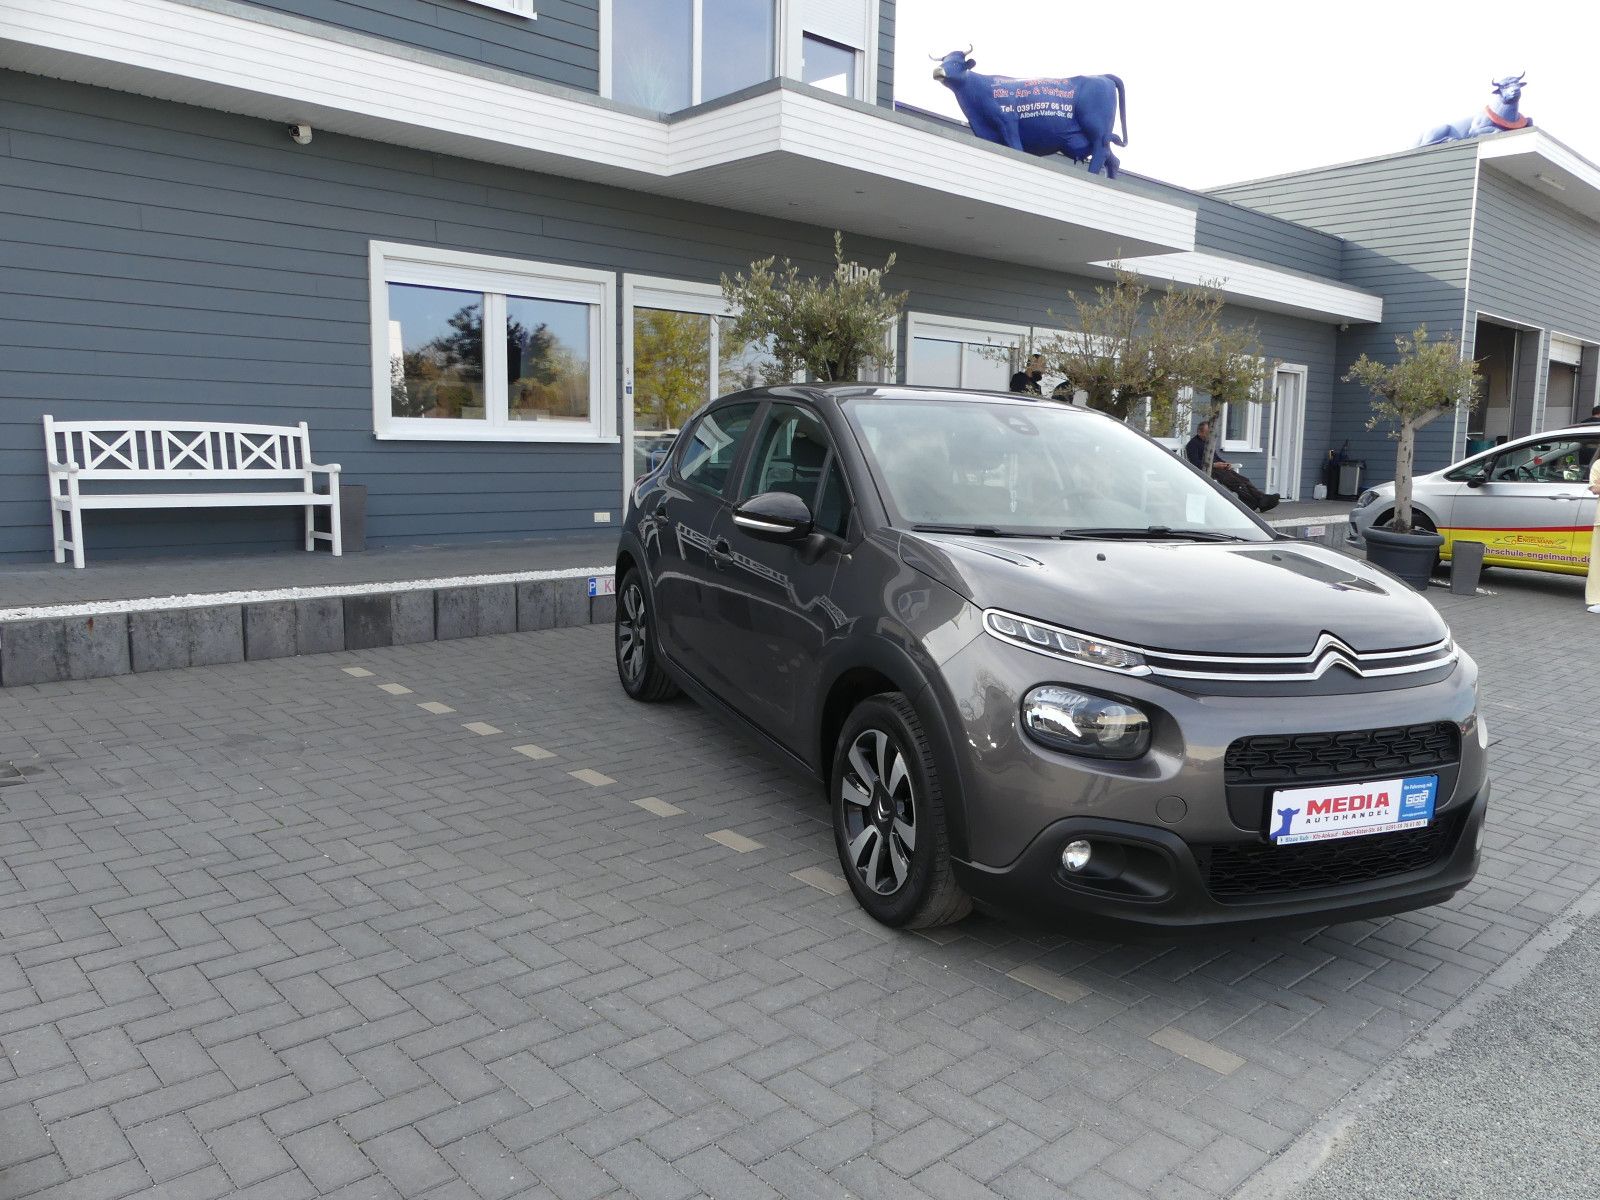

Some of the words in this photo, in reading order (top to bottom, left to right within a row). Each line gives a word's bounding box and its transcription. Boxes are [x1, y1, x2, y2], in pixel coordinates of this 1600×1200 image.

[1000, 105, 1014, 113] Tel.
[1016, 102, 1050, 113] 0391/597
[1061, 104, 1073, 112] 100
[1020, 109, 1067, 119] Albert-Vater-Str.
[1517, 535, 1554, 545] ENGELMANN
[604, 578, 616, 593] K
[1306, 792, 1390, 816] MEDIA
[1305, 809, 1389, 824] AUTOHANDEL
